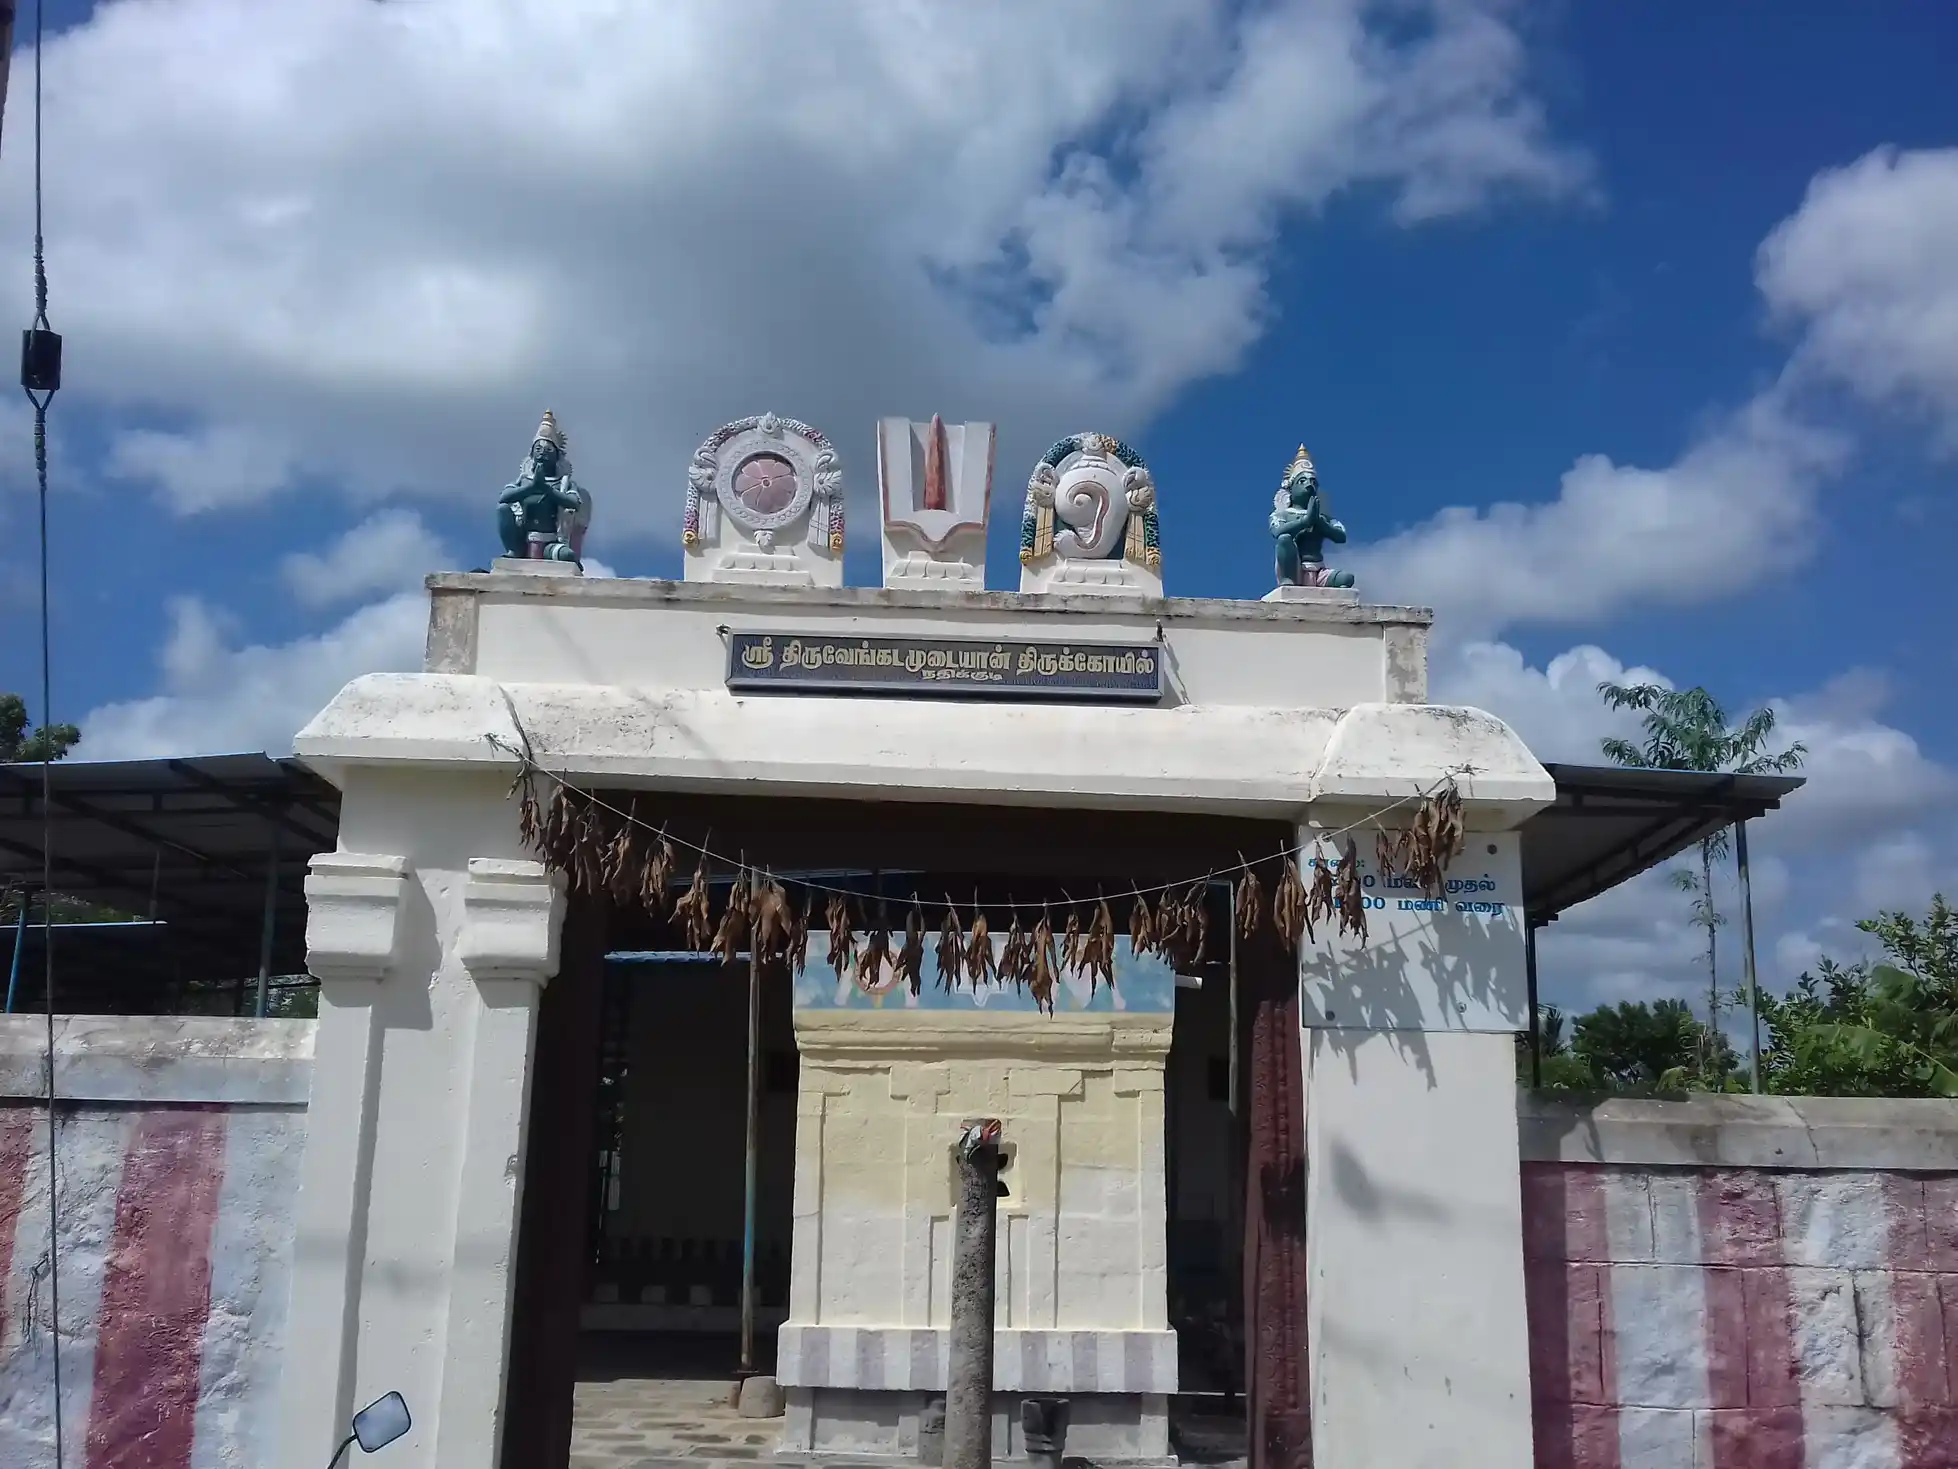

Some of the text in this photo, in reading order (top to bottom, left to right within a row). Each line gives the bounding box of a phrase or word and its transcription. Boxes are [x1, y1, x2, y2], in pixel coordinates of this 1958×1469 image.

[741, 636, 1155, 675] ஸ்ரீ திருவேங்கடமுடையான் திருக்கோயில்
[1445, 873, 1496, 893] முதல்
[1397, 897, 1446, 912] மணி
[1455, 900, 1505, 916] வரை
